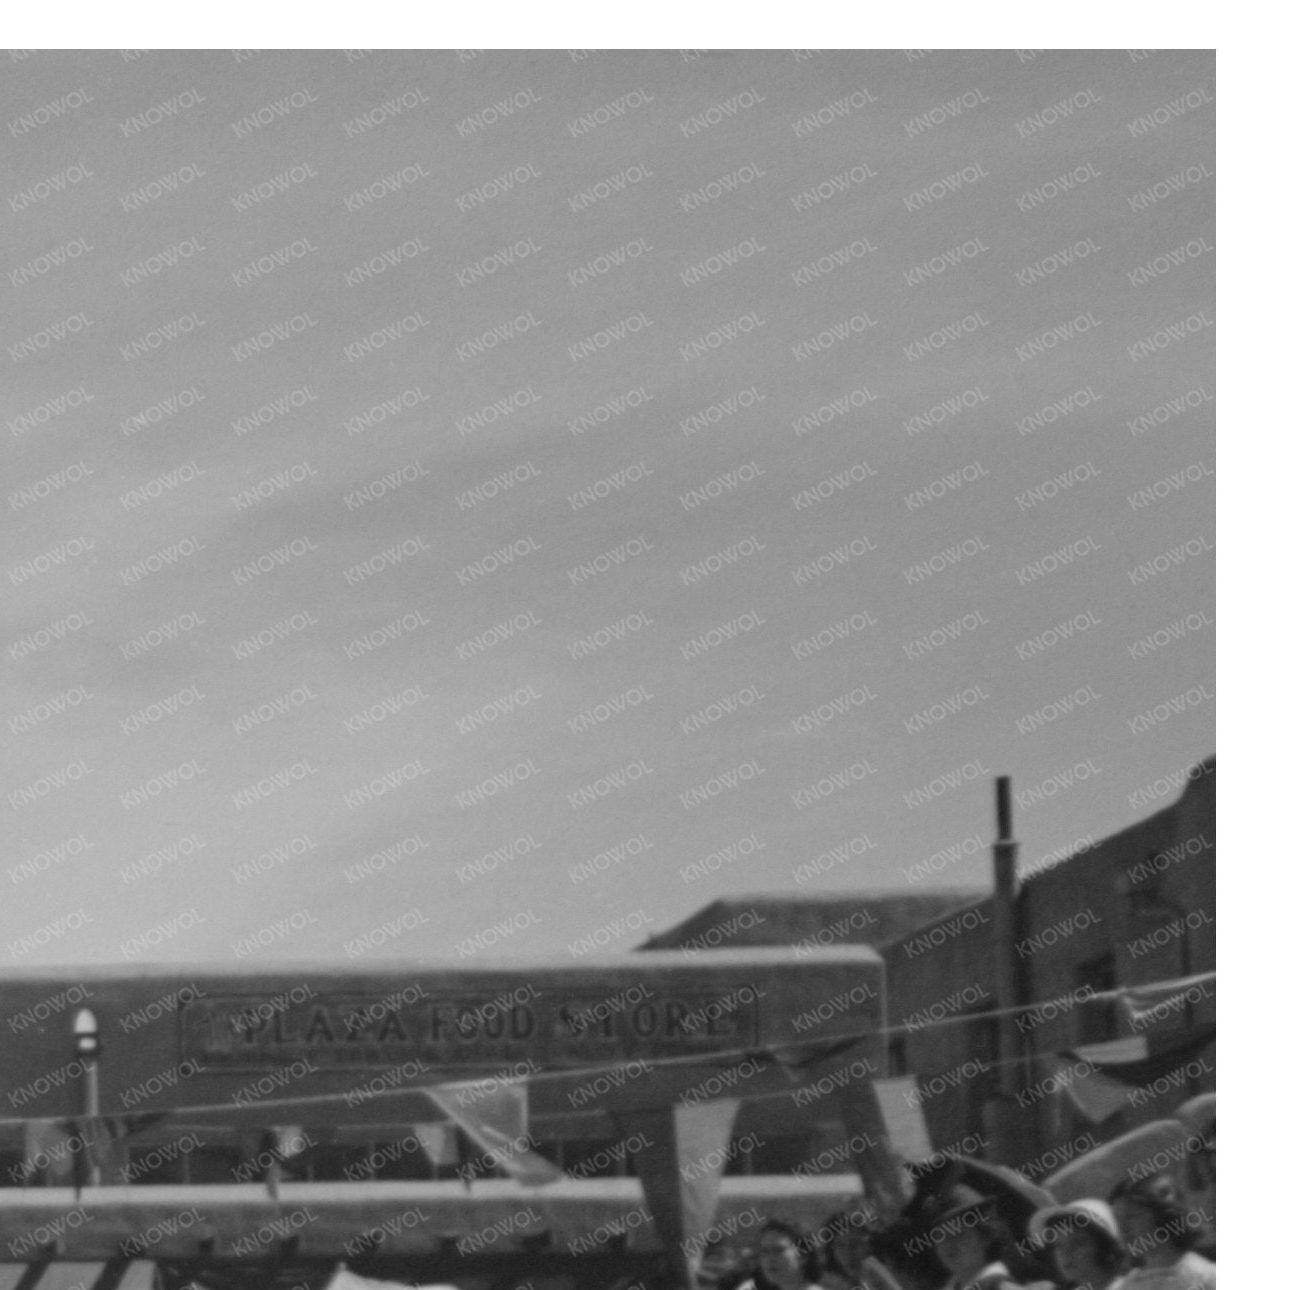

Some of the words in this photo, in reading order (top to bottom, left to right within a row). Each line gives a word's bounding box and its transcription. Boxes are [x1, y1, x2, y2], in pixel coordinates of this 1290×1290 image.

[243, 1006, 409, 1044] PLAZA
[431, 1004, 535, 1041] FOOD
[558, 999, 732, 1038] STORE
